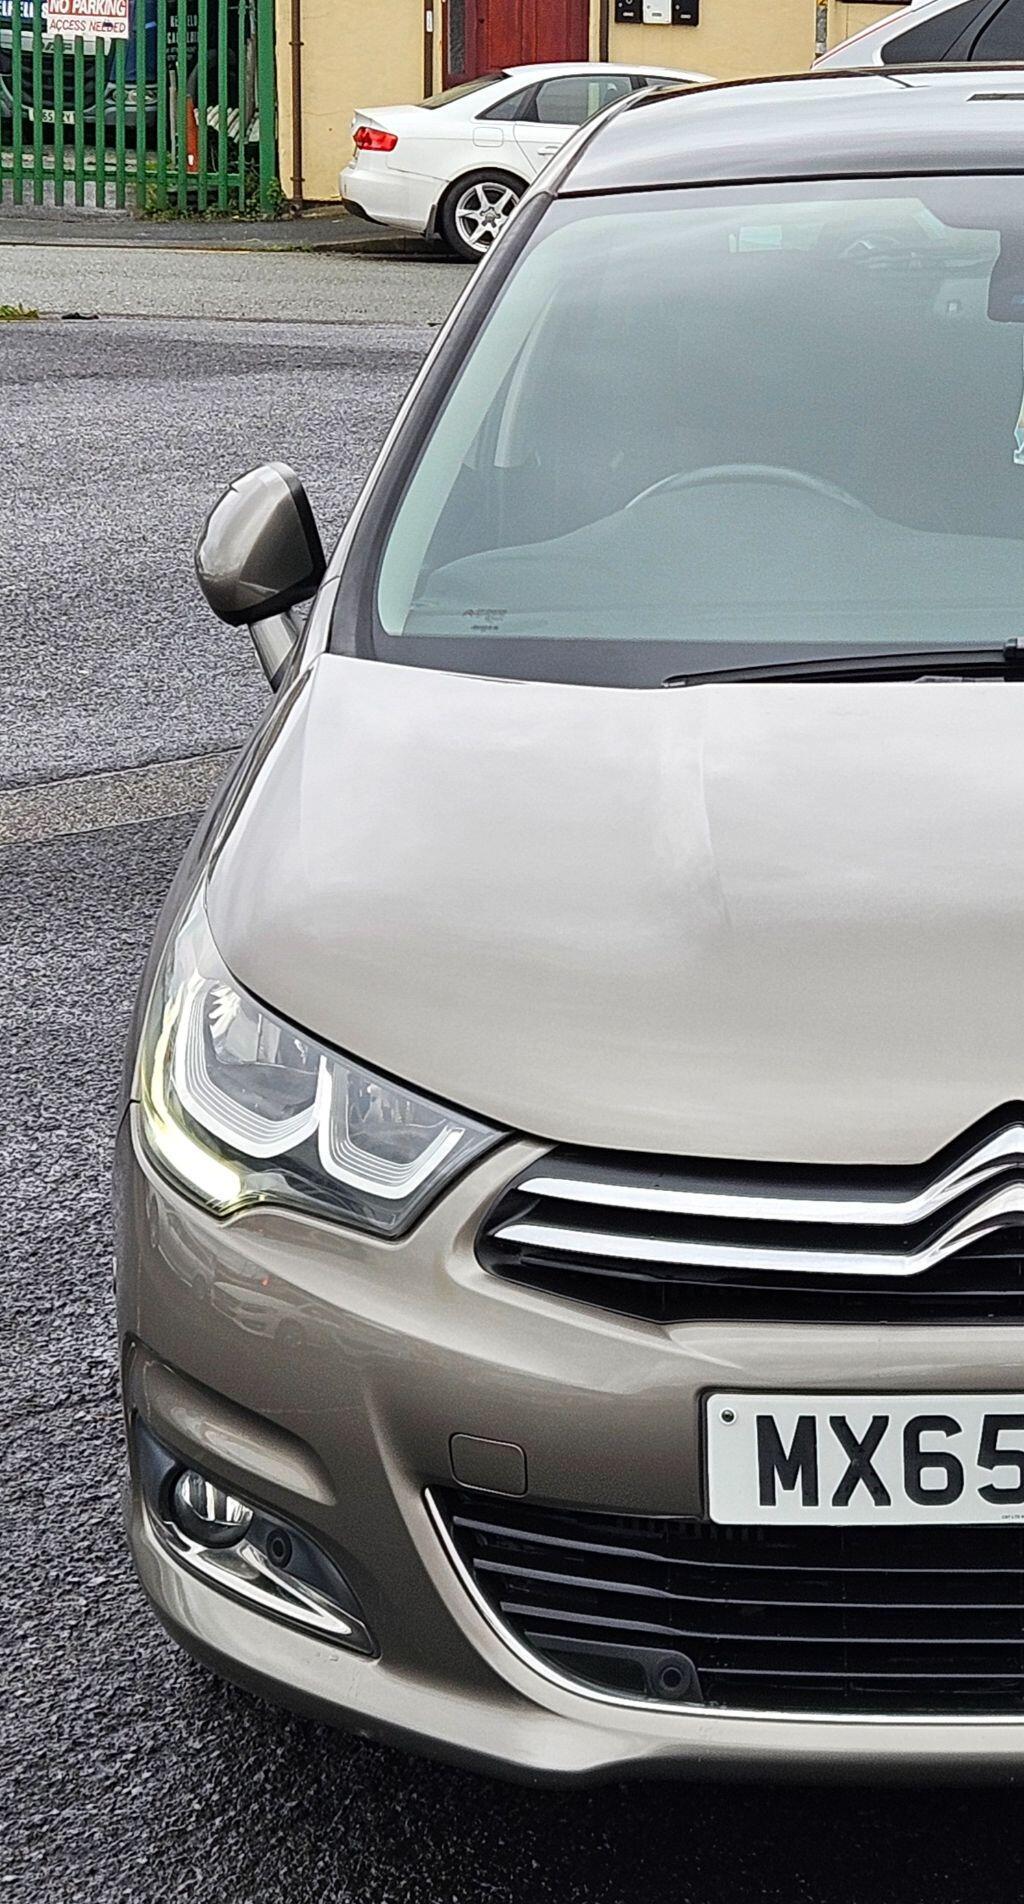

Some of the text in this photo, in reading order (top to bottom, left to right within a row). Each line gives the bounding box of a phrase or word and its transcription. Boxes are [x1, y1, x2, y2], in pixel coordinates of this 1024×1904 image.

[48, 0, 69, 13] NO
[71, 0, 127, 16] PARKING
[50, 20, 126, 33] ACCESS NEEDED
